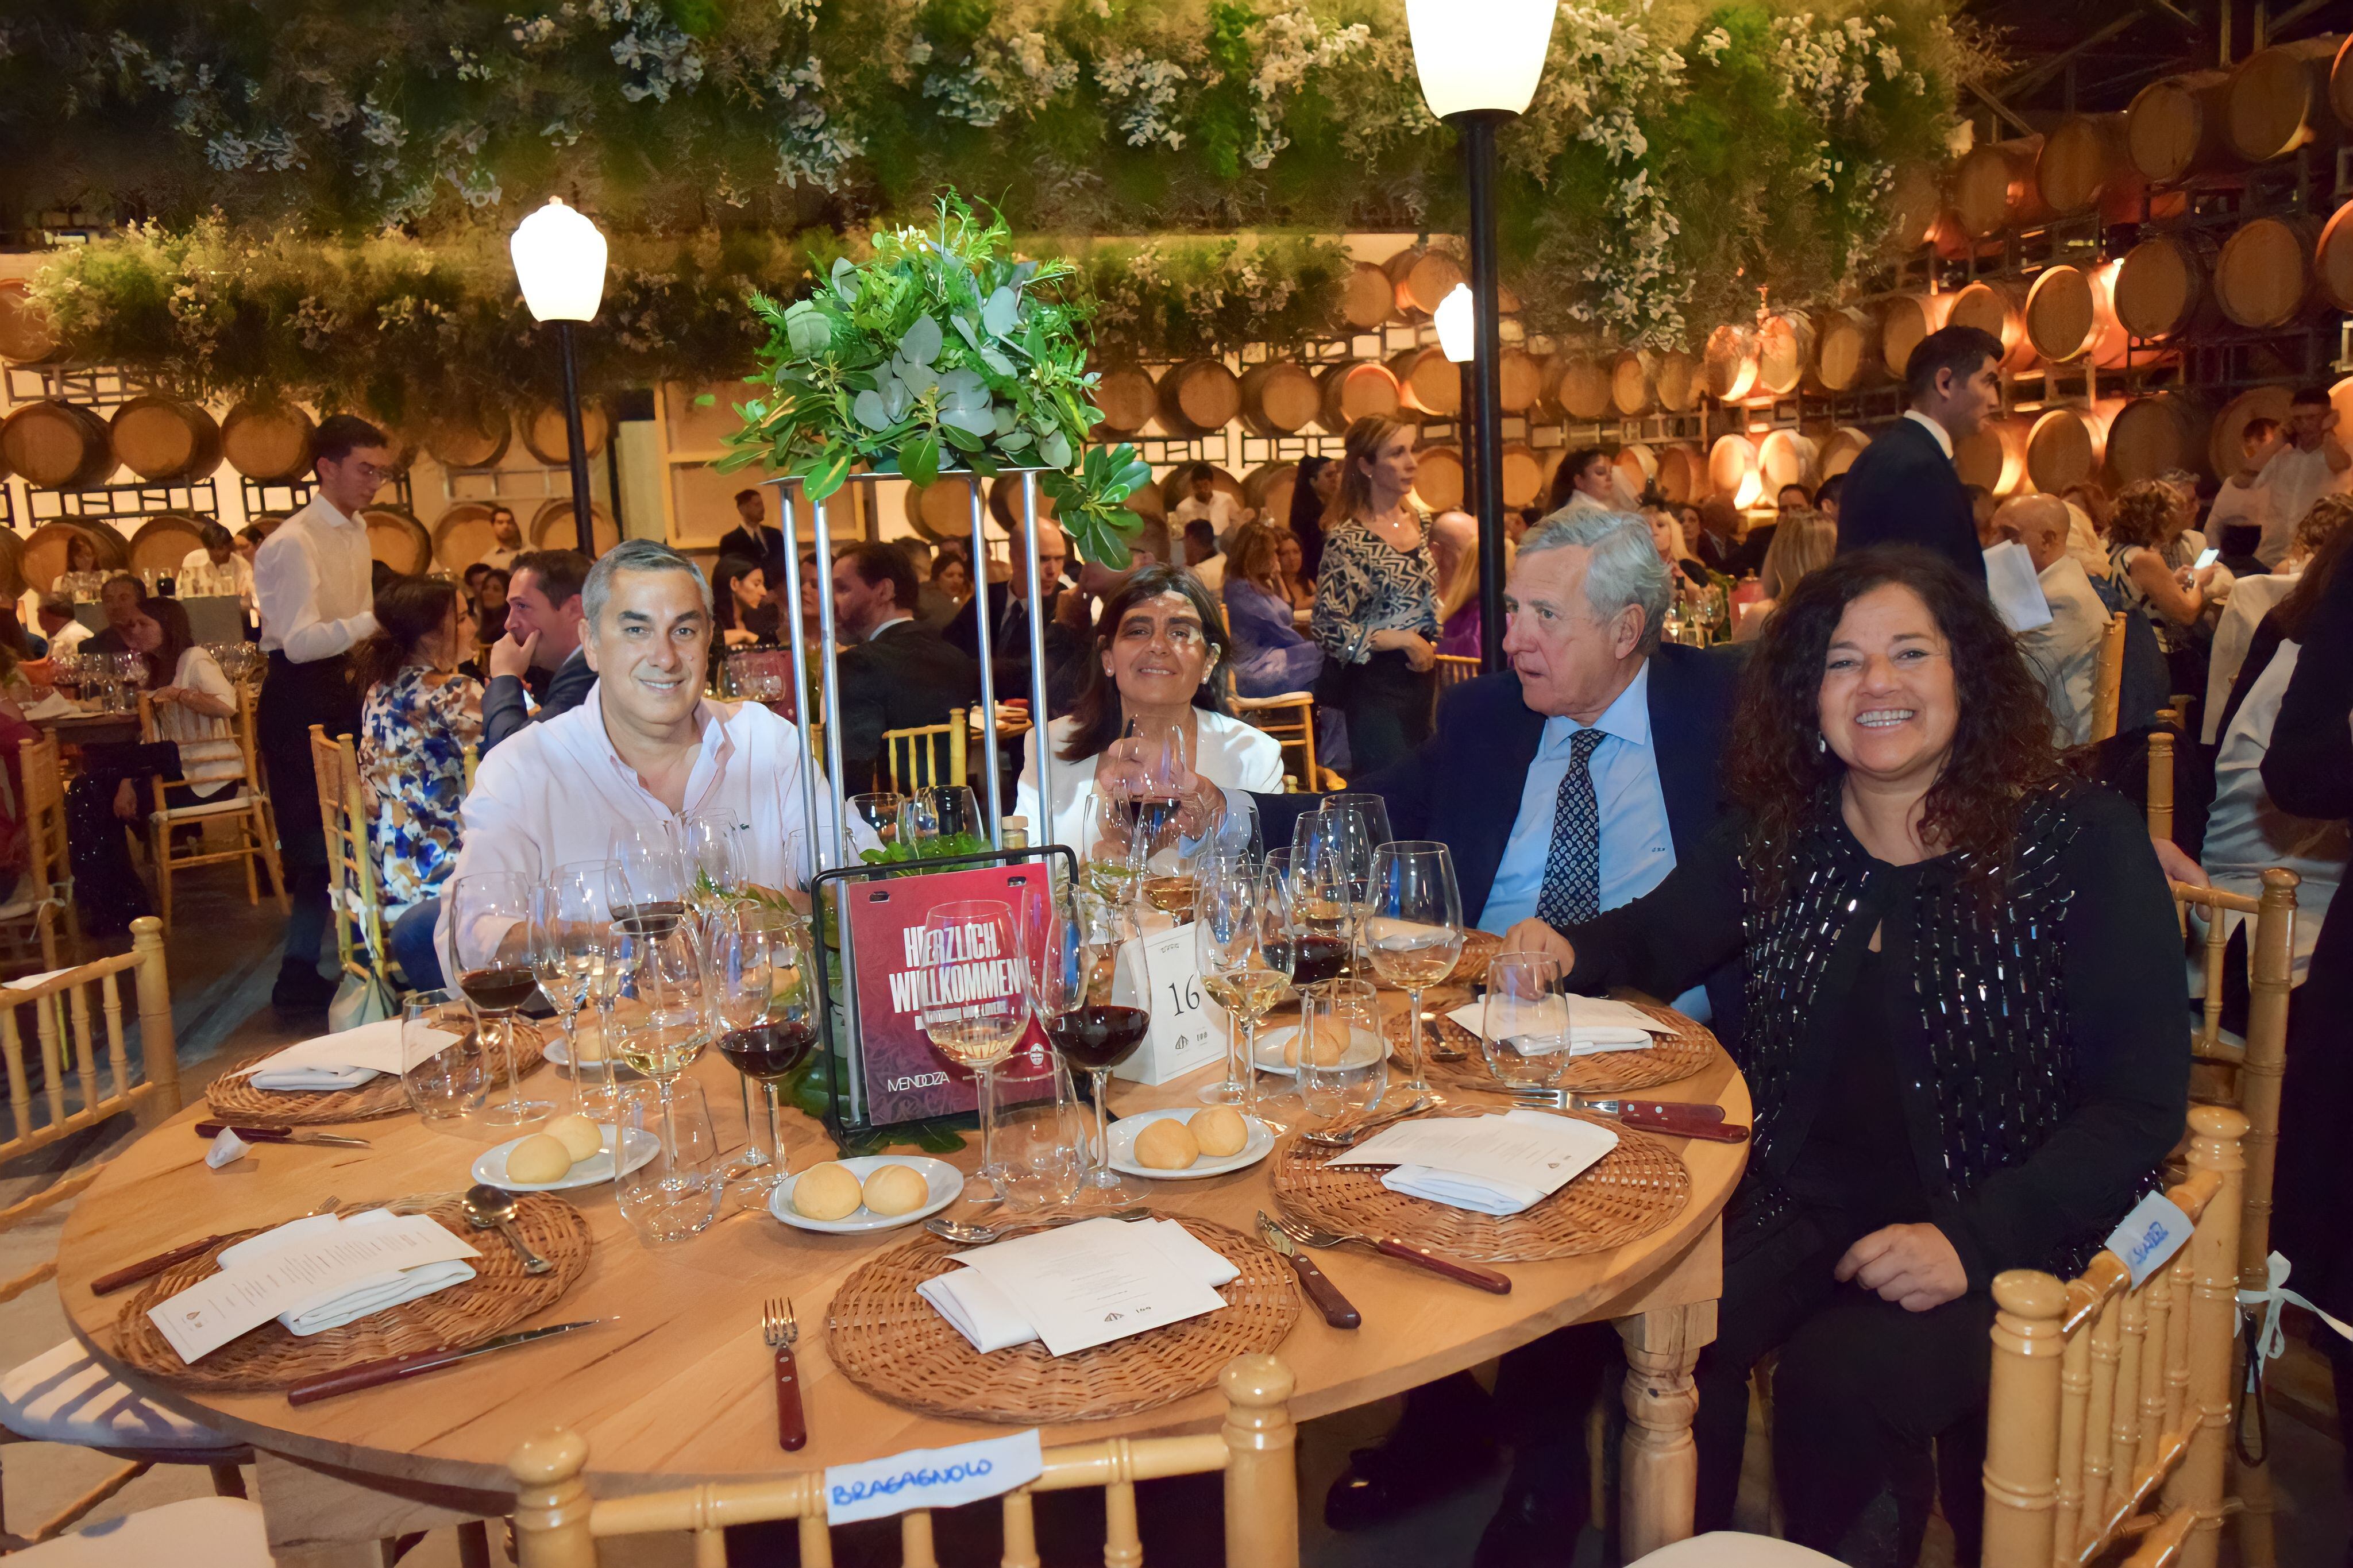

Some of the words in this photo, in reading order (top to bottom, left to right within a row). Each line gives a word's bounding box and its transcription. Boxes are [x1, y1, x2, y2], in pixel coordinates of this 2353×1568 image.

[903, 922, 998, 968] HERZLICH
[889, 956, 1033, 1013] WILLKOMMEN
[1168, 974, 1200, 1017] 16
[888, 1072, 950, 1092] MENDOZA
[832, 1459, 992, 1505] BRAGAGNOLO
